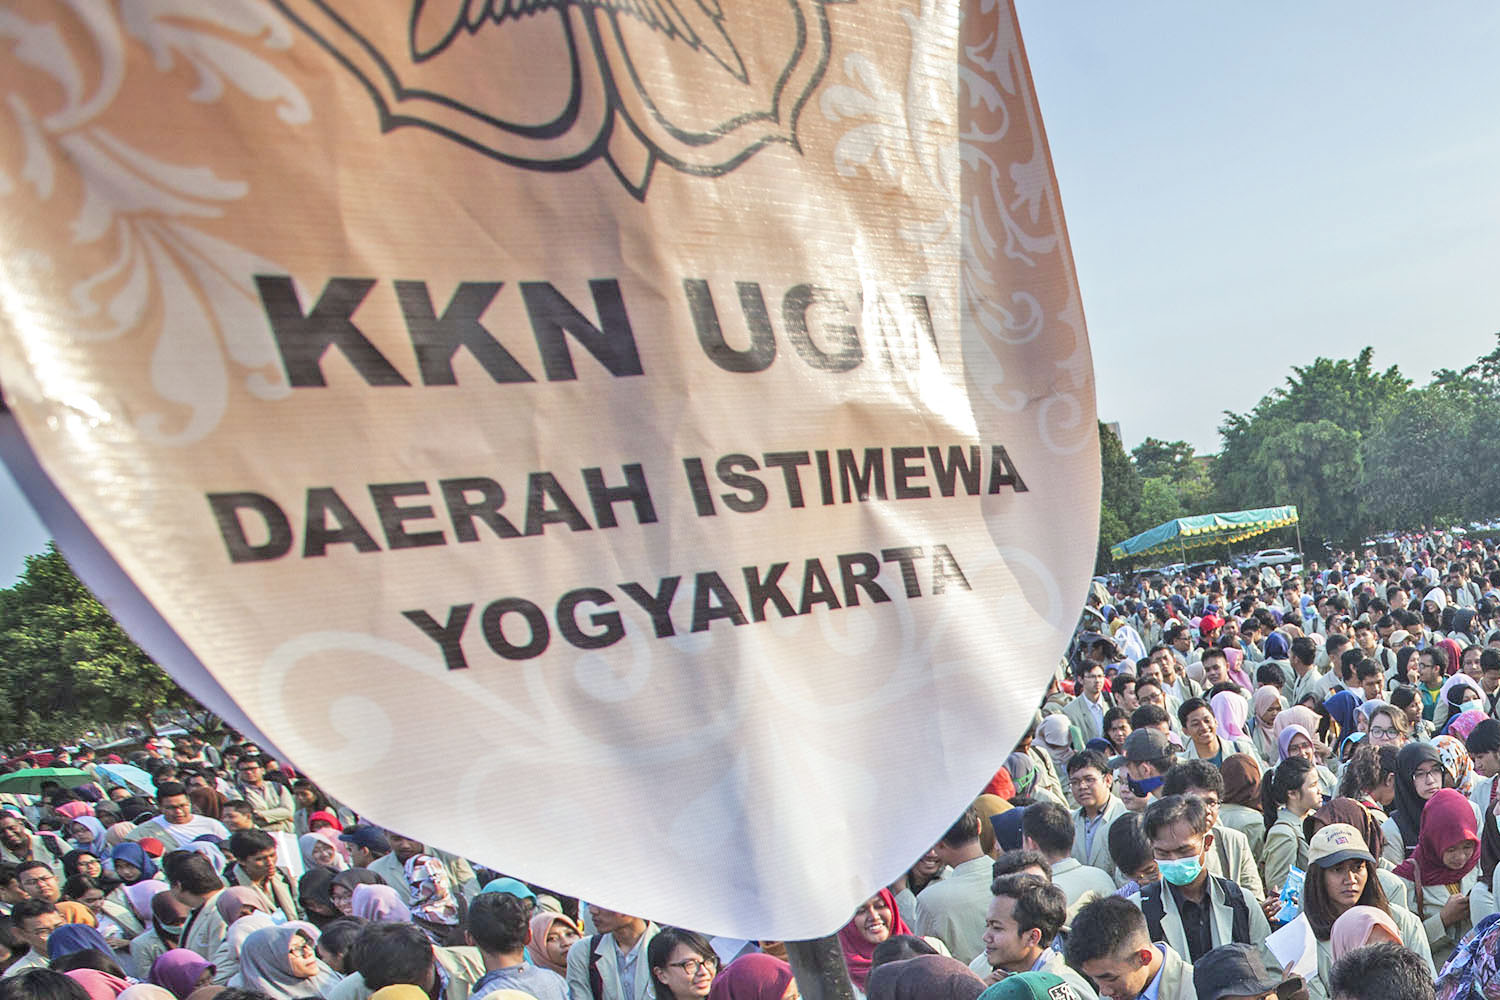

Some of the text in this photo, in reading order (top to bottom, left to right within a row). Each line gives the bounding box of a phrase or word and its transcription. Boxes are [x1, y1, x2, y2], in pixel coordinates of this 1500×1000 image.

[254, 275, 646, 389] KKN
[206, 444, 1029, 564] DAERAH ISTIMEWA
[403, 543, 973, 672] YOGYAKARTA
